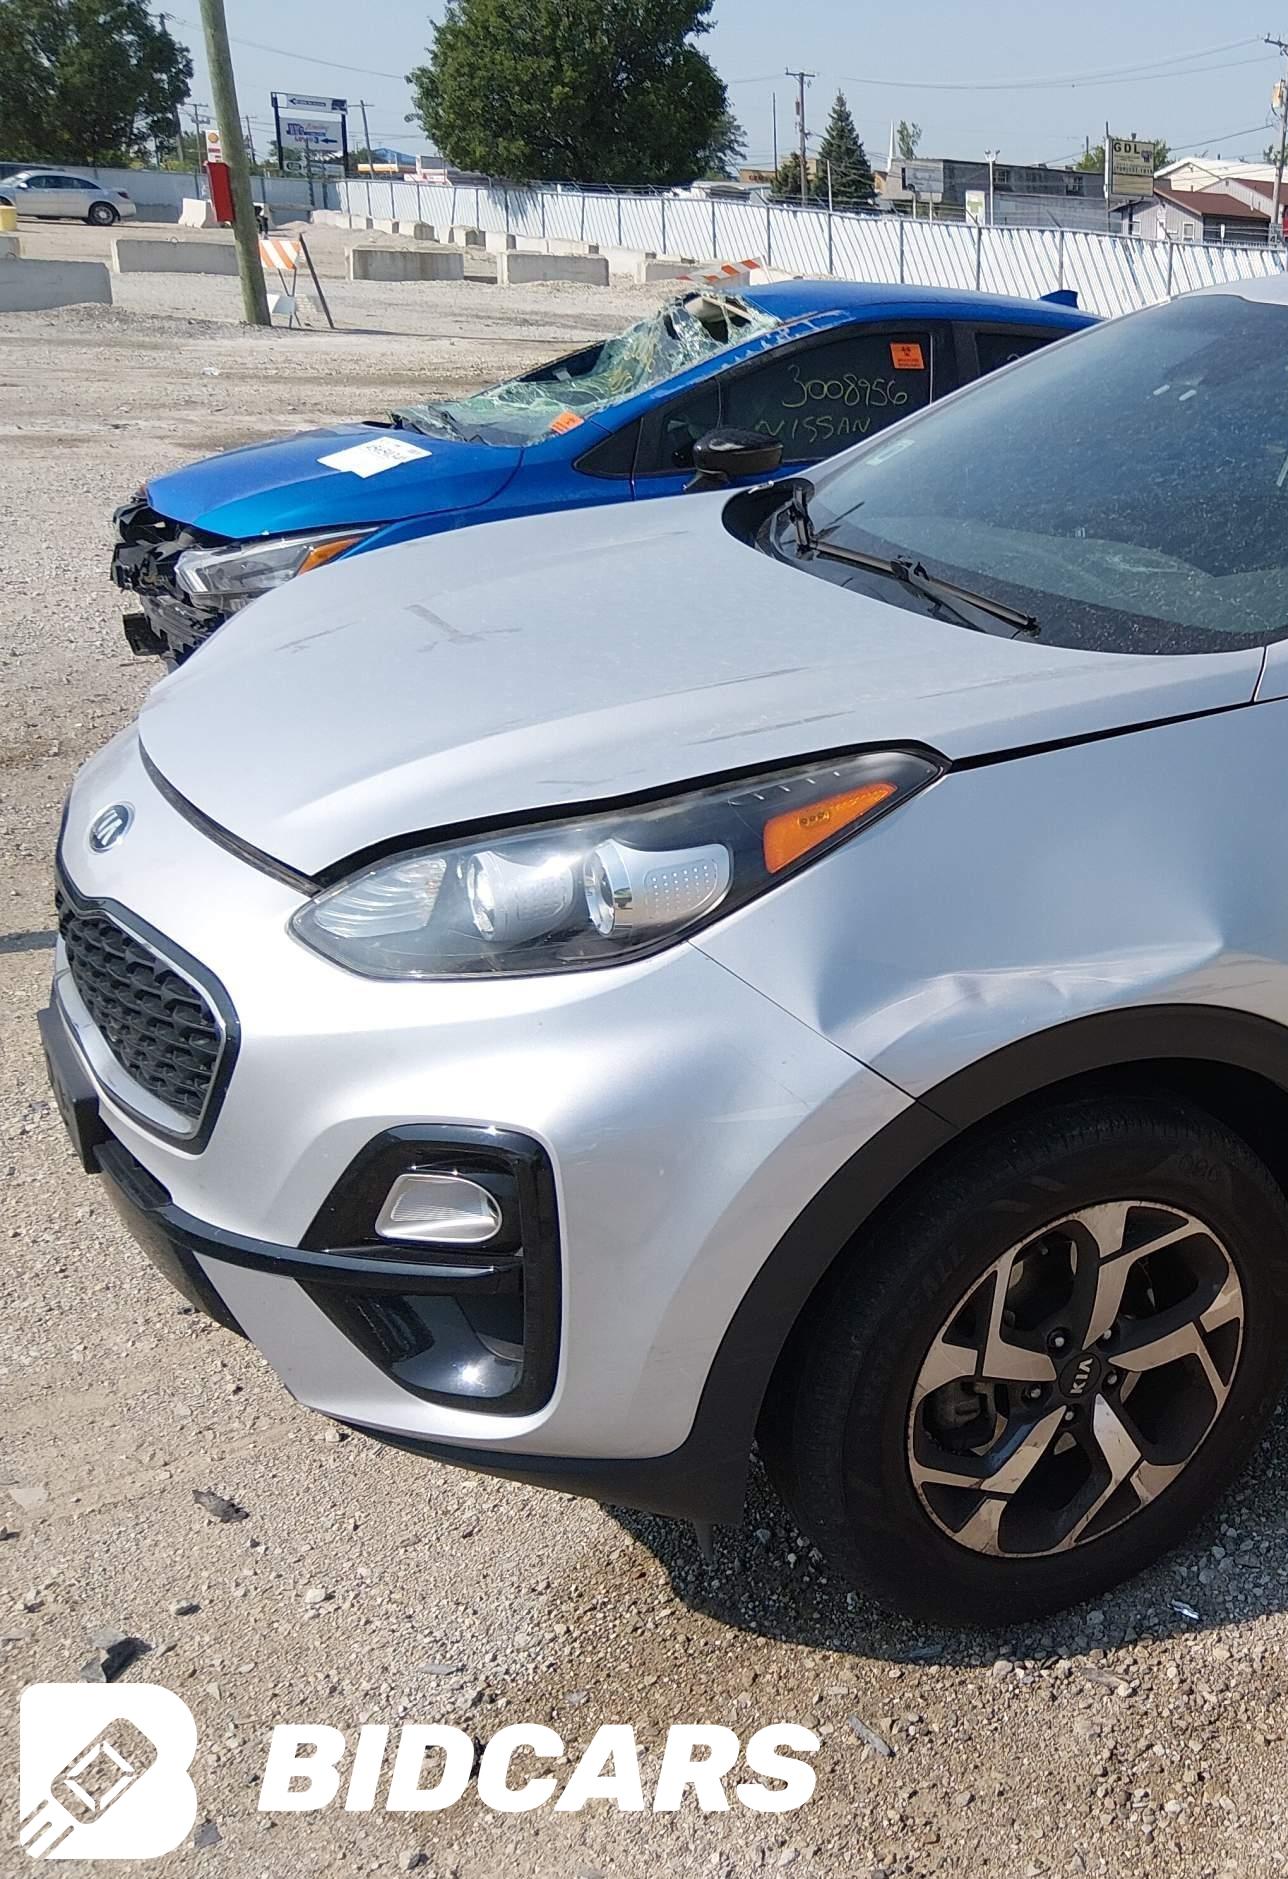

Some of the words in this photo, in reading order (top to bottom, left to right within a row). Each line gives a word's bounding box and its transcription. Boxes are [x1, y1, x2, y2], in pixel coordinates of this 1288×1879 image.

[1113, 142, 1140, 155] GDL
[782, 364, 908, 408] 3008956
[755, 415, 871, 443] NISSAN
[1070, 1358, 1094, 1394] KIA
